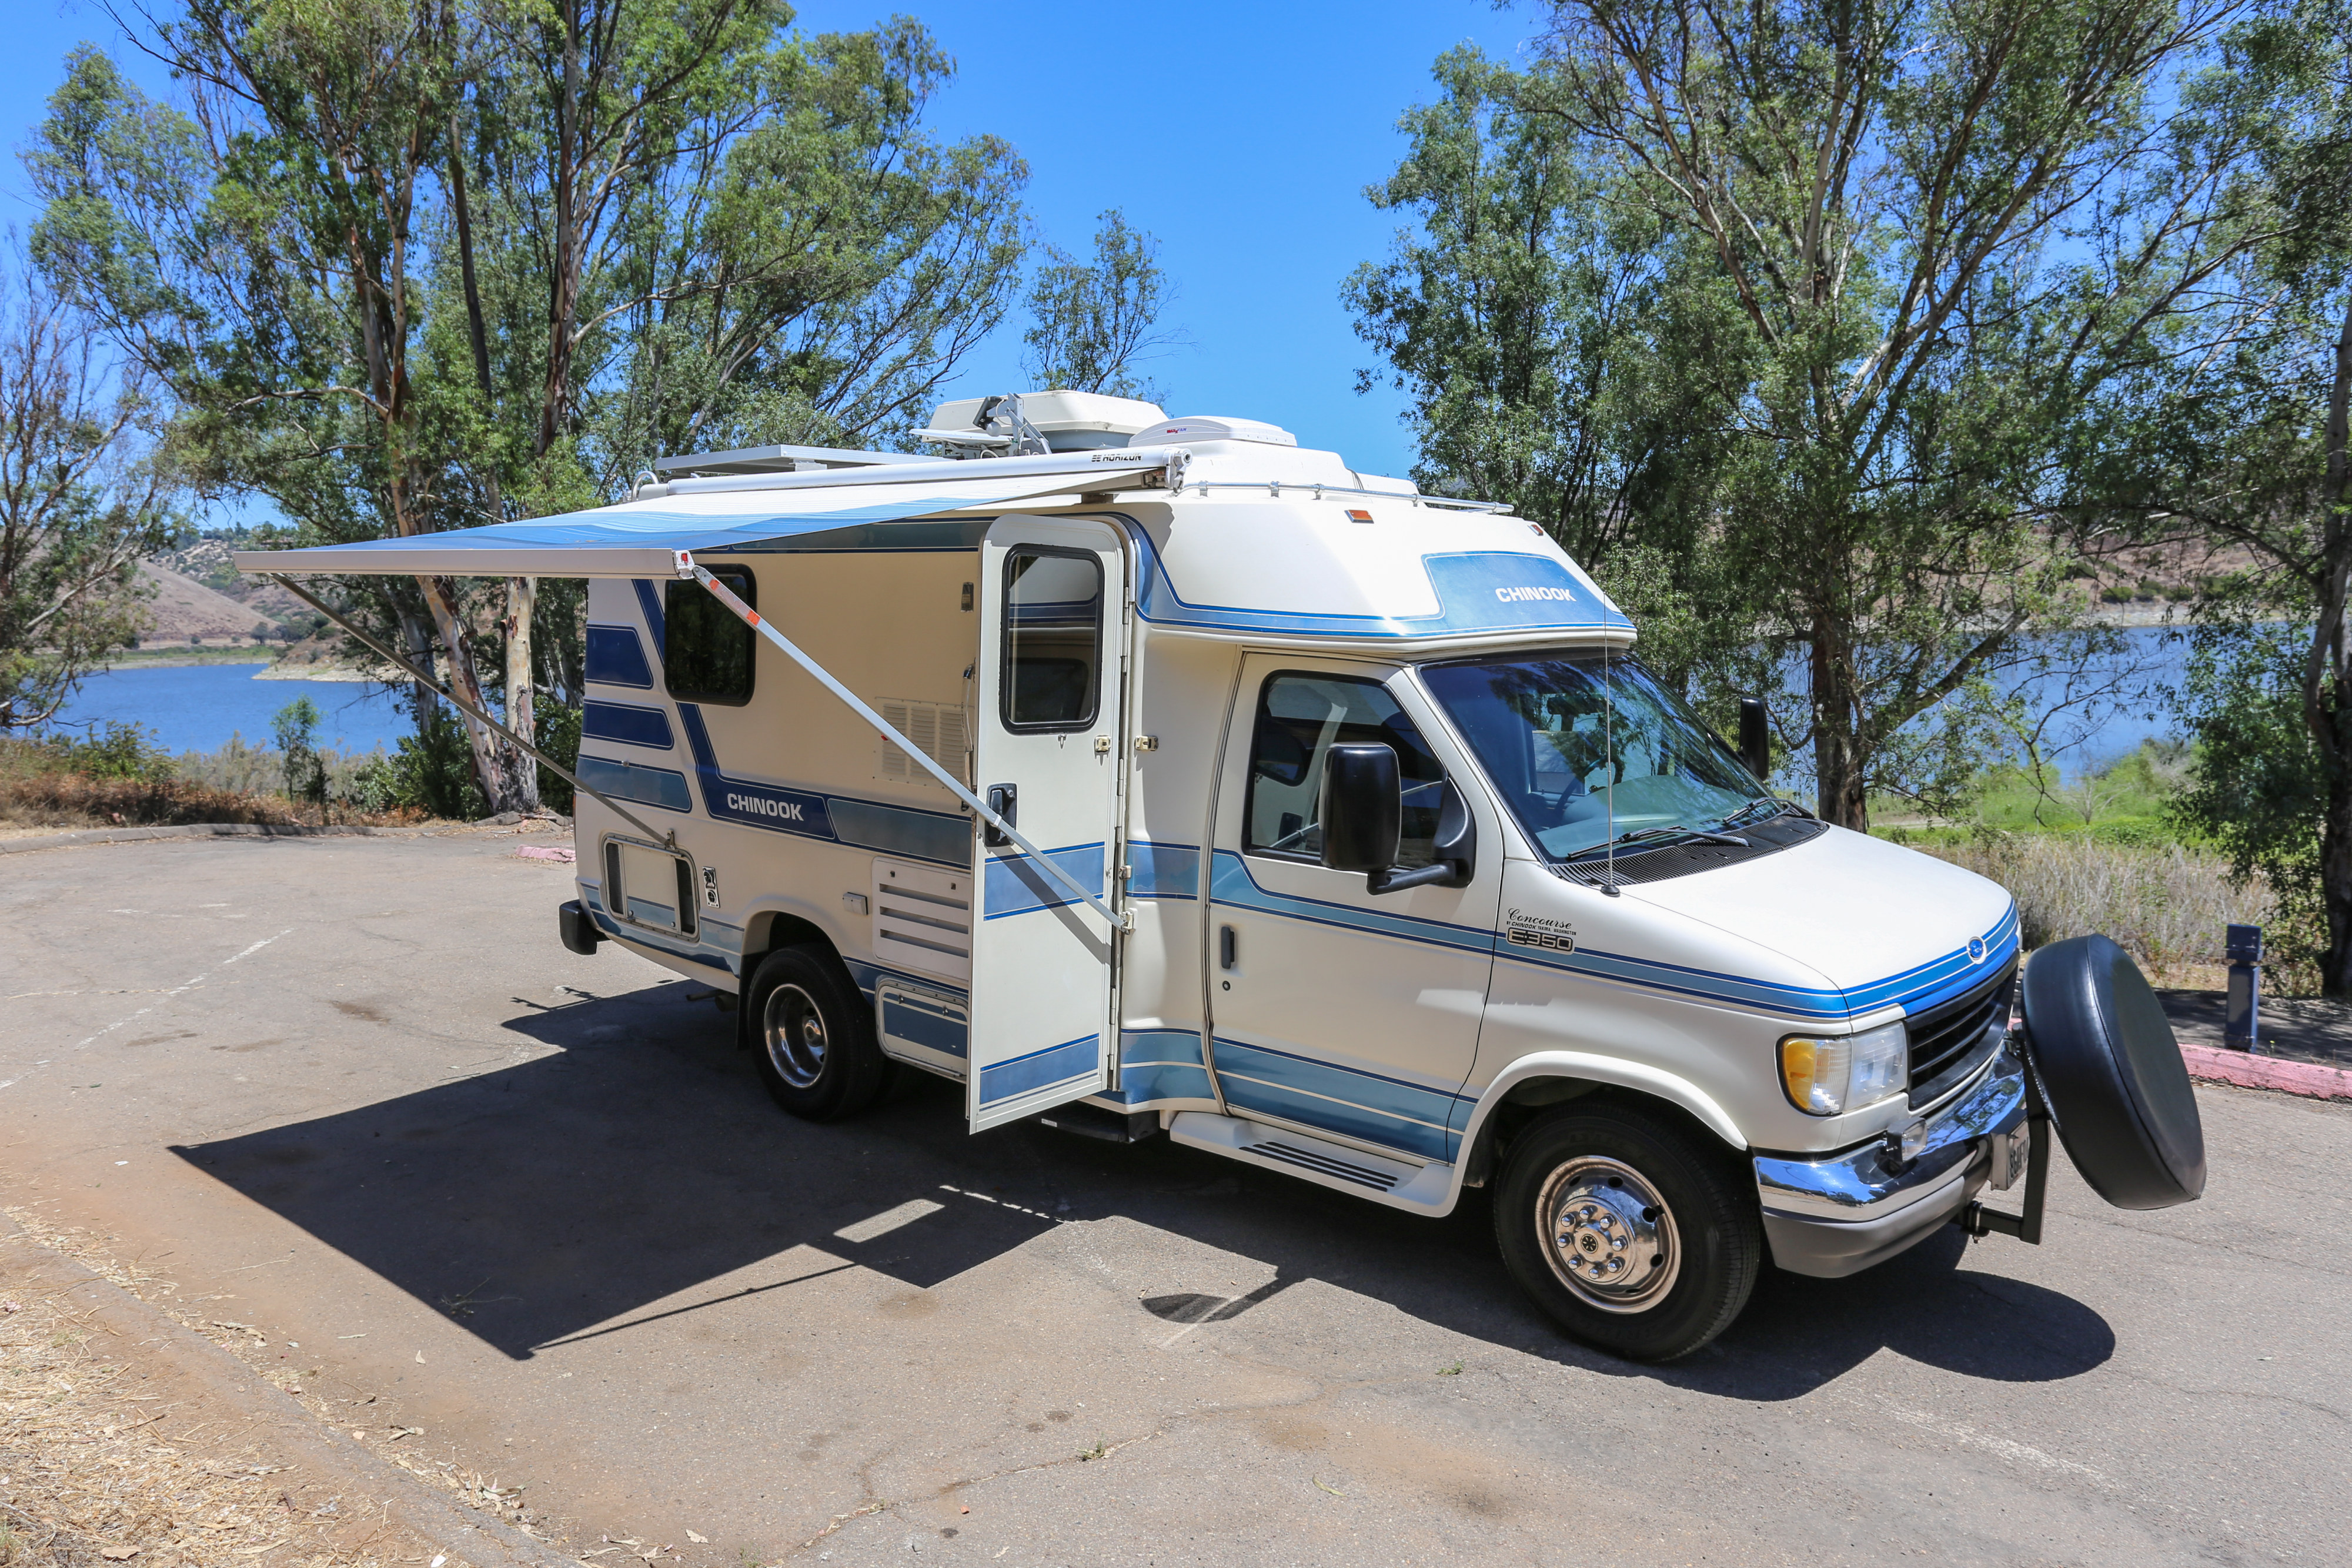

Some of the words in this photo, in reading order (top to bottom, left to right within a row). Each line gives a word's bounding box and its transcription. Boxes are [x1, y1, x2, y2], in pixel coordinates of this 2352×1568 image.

[1495, 587, 1577, 602] CHINOOK
[727, 793, 804, 821] CHINOOK
[1508, 908, 1572, 930] Concourse
[1512, 921, 1536, 930] CHINOOK
